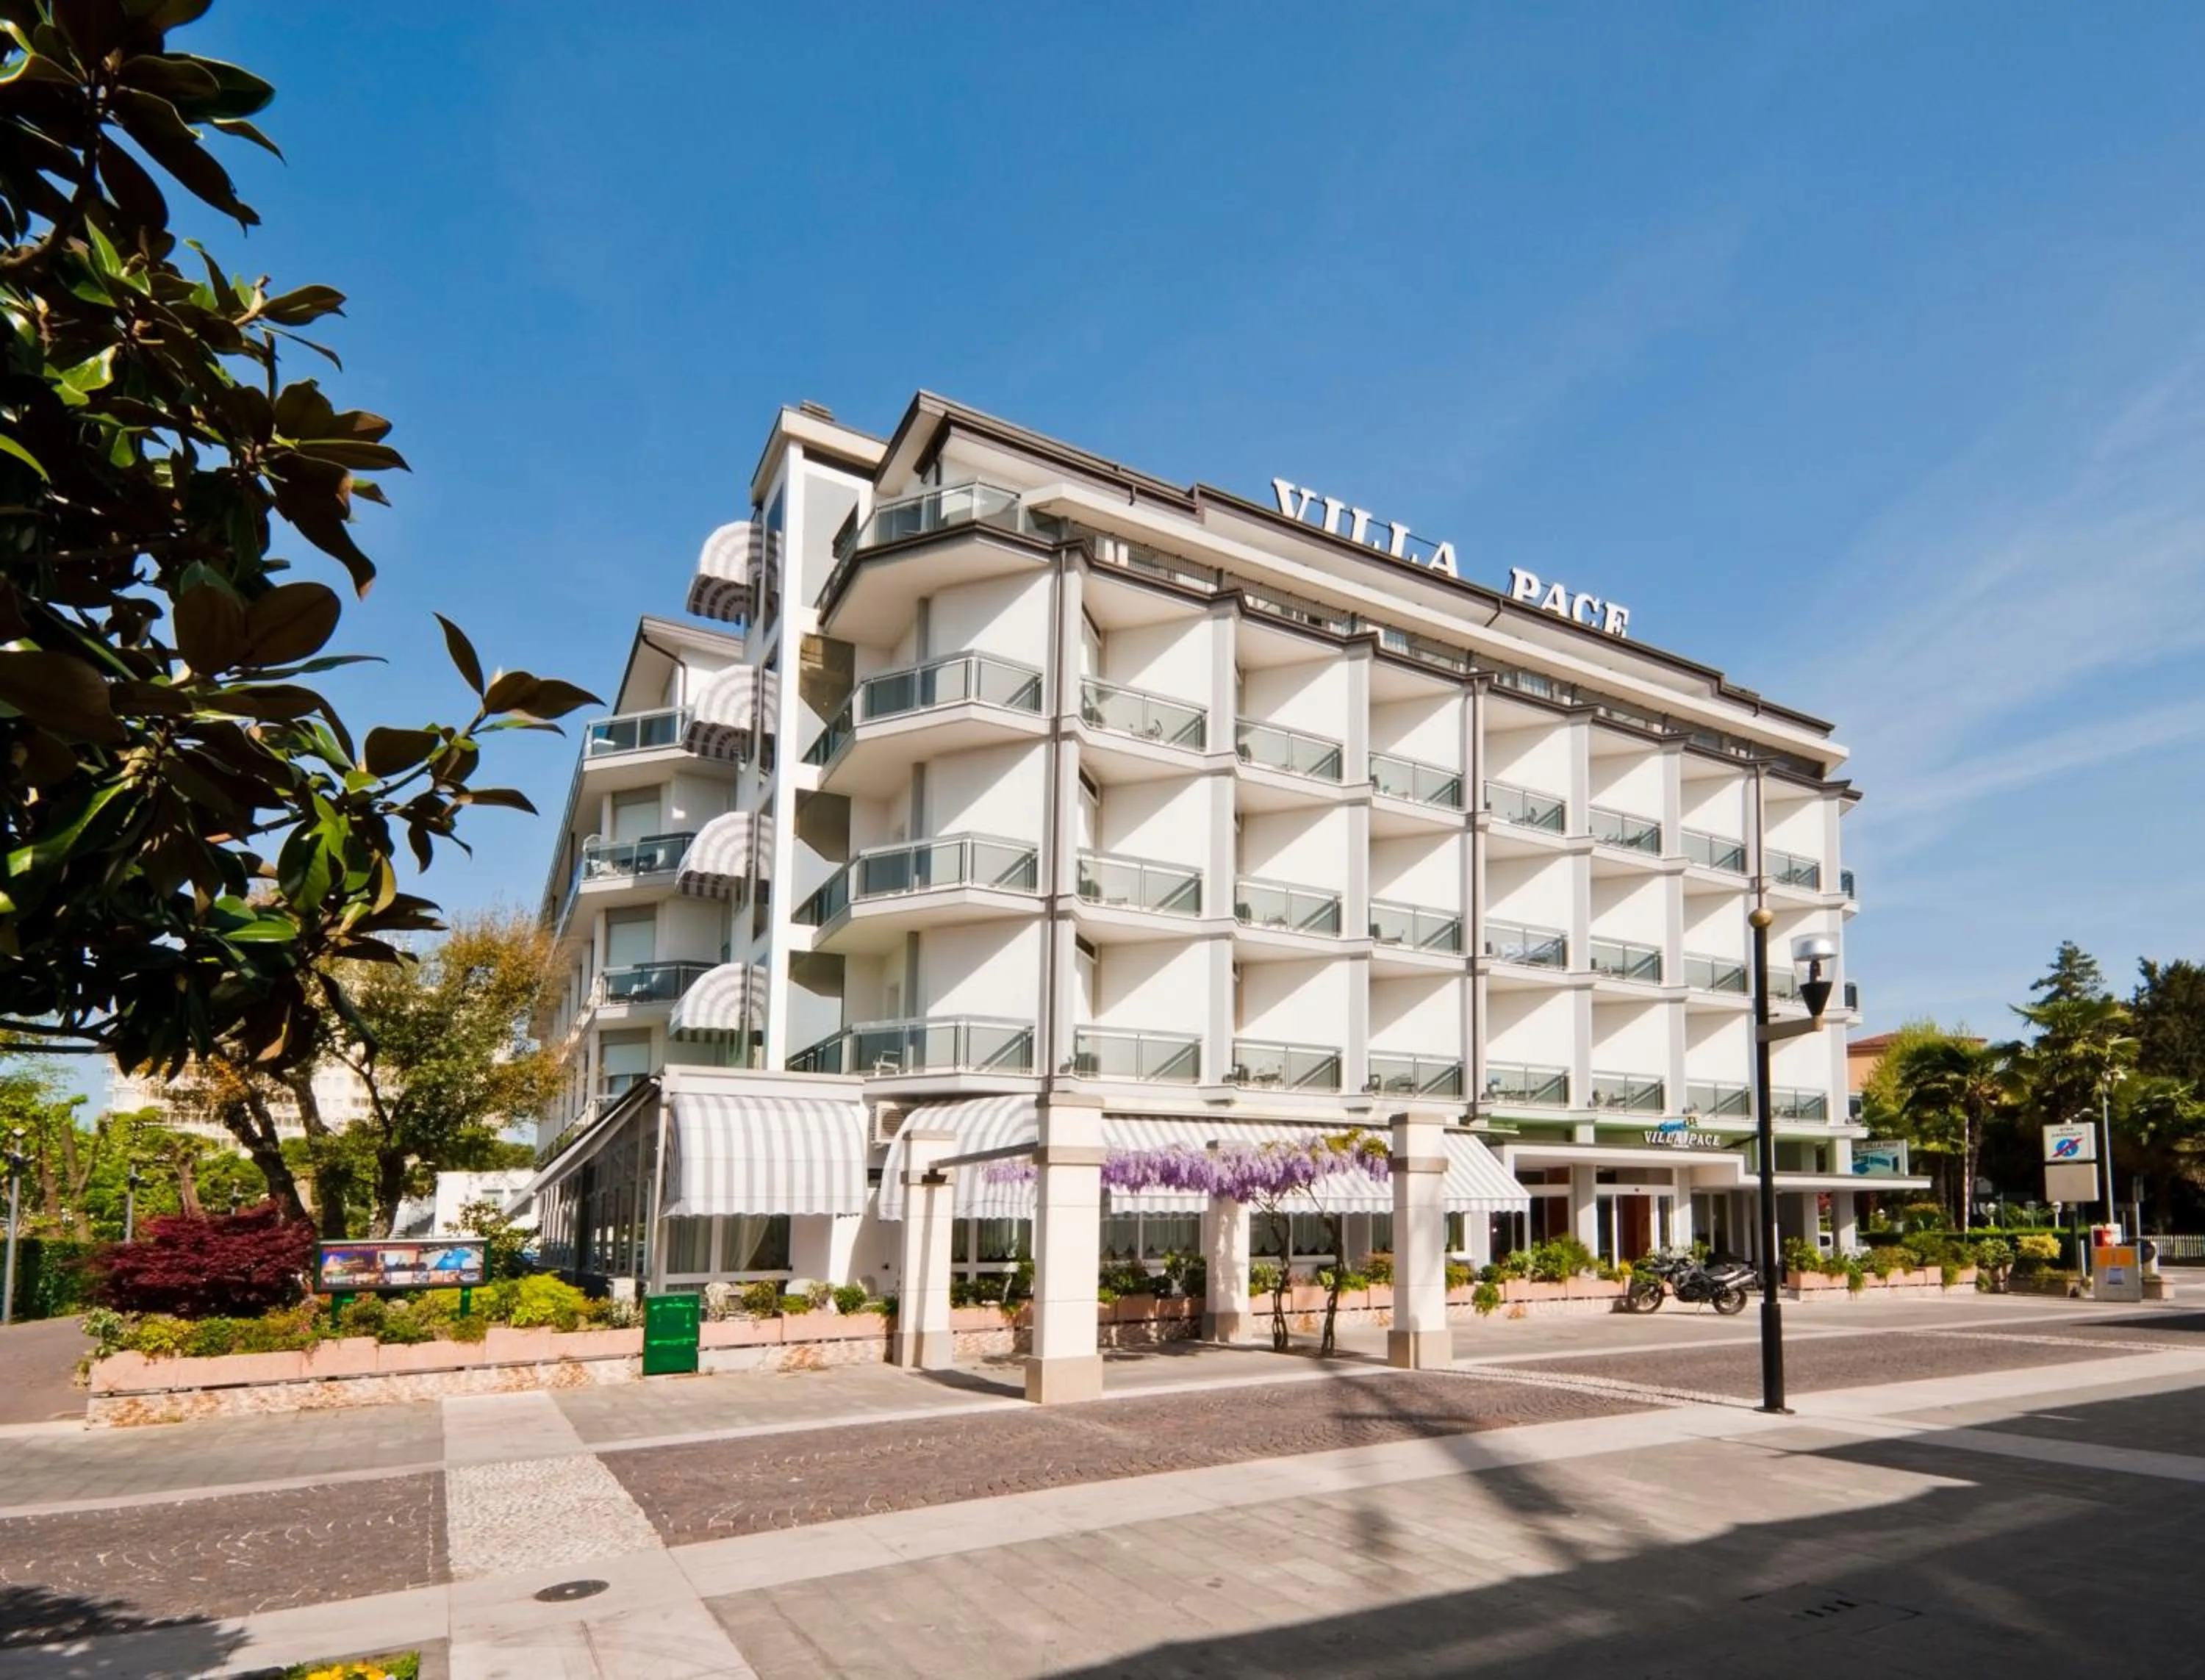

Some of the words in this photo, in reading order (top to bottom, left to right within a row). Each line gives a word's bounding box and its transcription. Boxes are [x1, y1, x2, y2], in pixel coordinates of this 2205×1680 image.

[1272, 477, 1459, 578] VILLA
[1509, 566, 1630, 639] PACE
[1644, 1130, 1686, 1146] VILLA
[1688, 1132, 1721, 1146] PACE
